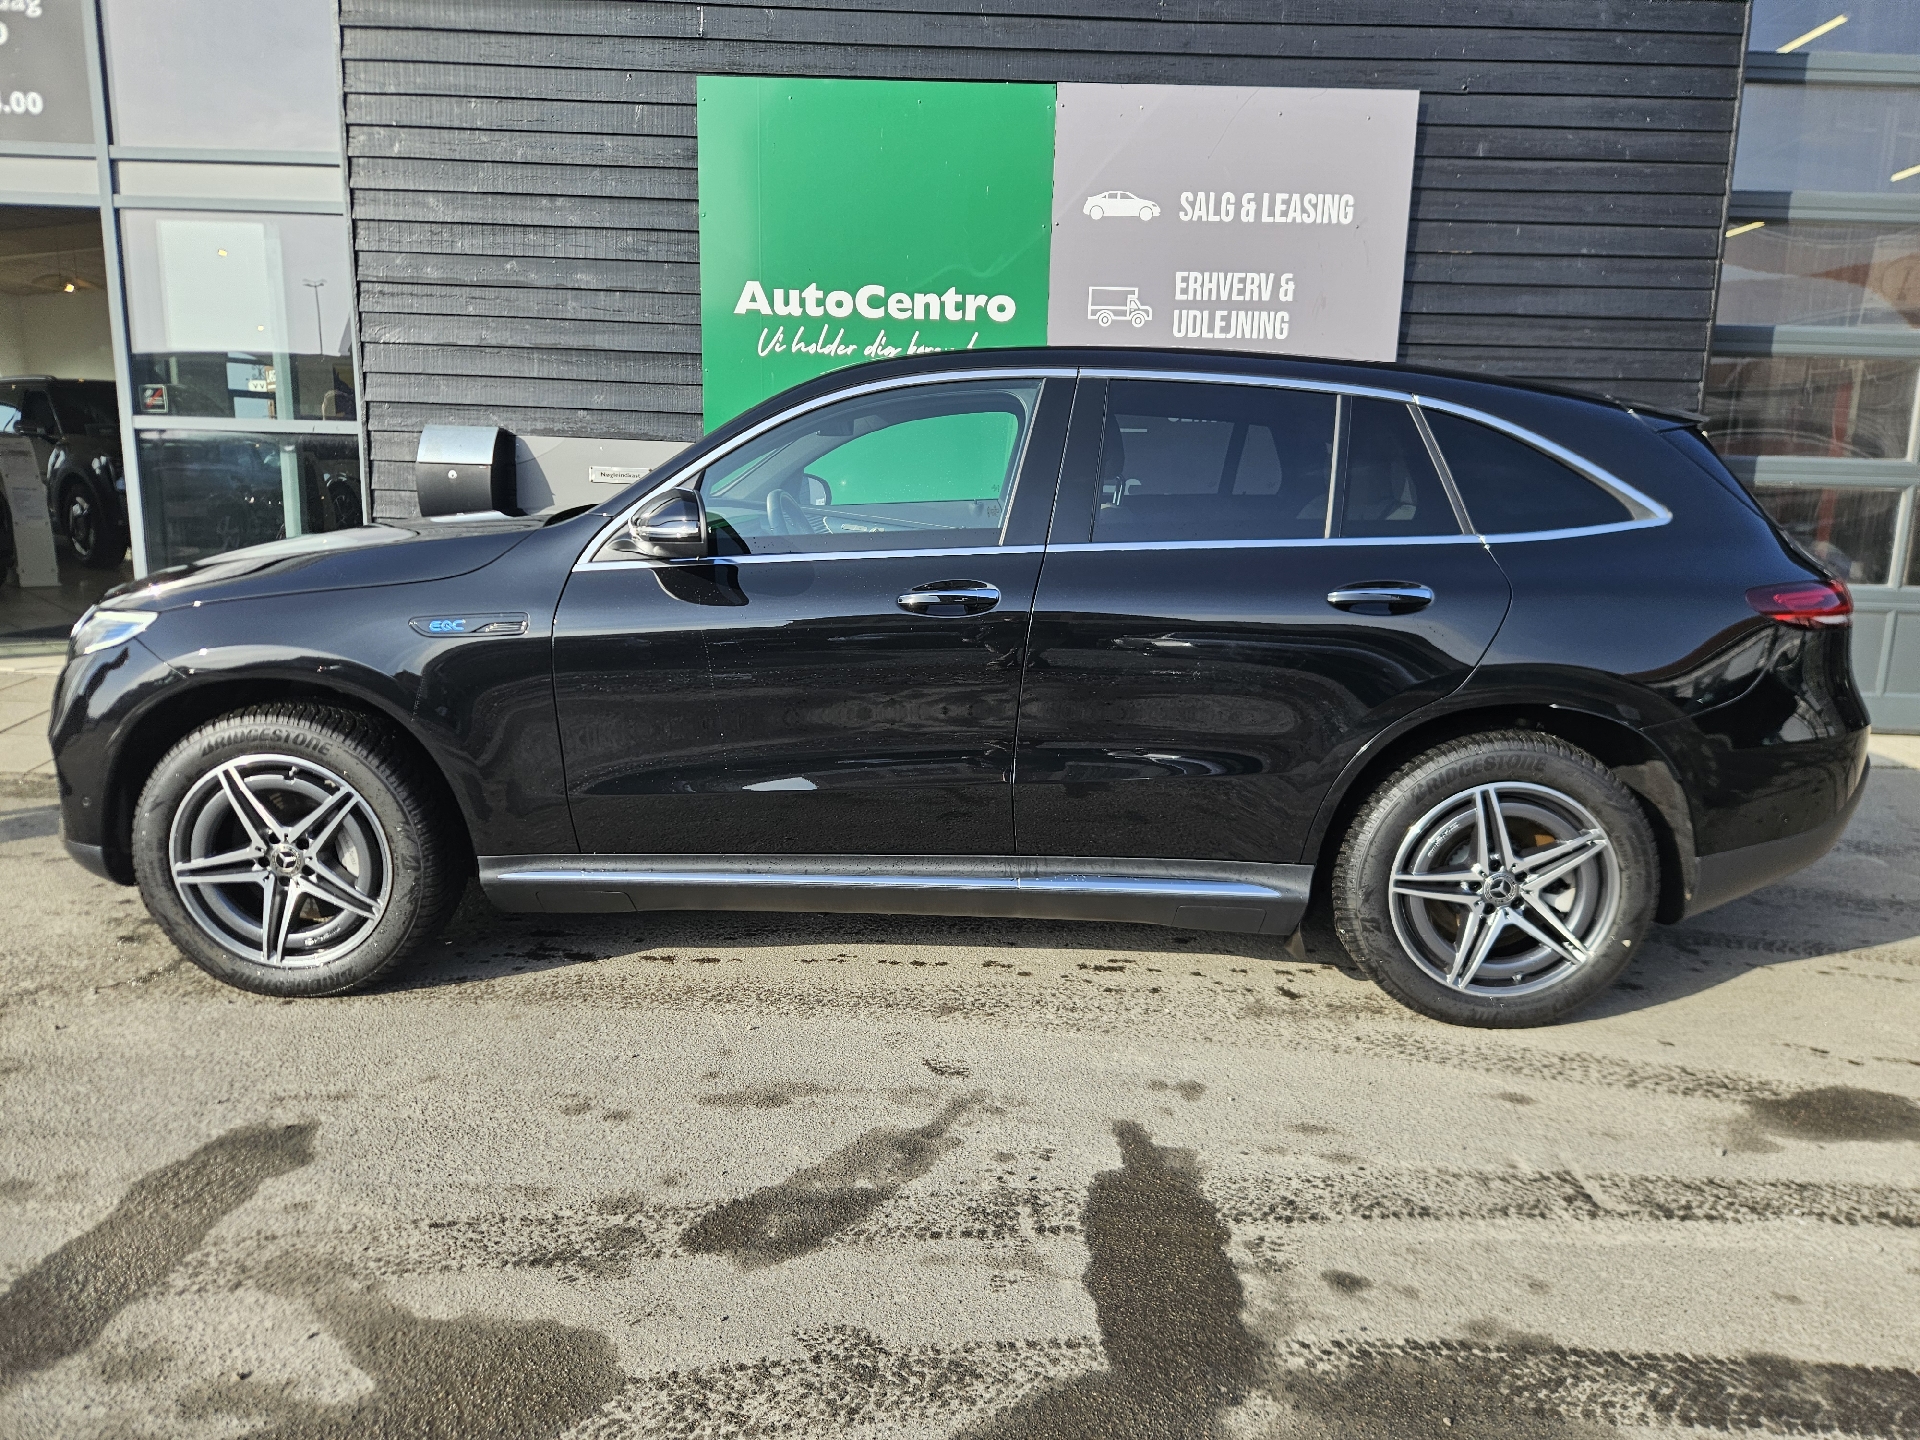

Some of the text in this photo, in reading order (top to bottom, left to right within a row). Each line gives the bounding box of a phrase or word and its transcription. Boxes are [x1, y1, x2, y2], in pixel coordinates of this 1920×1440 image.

[0, 90, 44, 115] .00
[1179, 191, 1354, 225] SALG & LEASING
[733, 280, 1016, 322] AutoCentro
[1175, 271, 1295, 302] ERHVERV &
[1172, 309, 1290, 339] UDLEJNING
[757, 326, 786, 357] Vi
[791, 324, 858, 356] holder
[863, 329, 902, 357] dig
[429, 619, 466, 632] EQC
[201, 727, 333, 757] BRIDGESTONE
[1411, 755, 1547, 802] BRIDGESTONE
